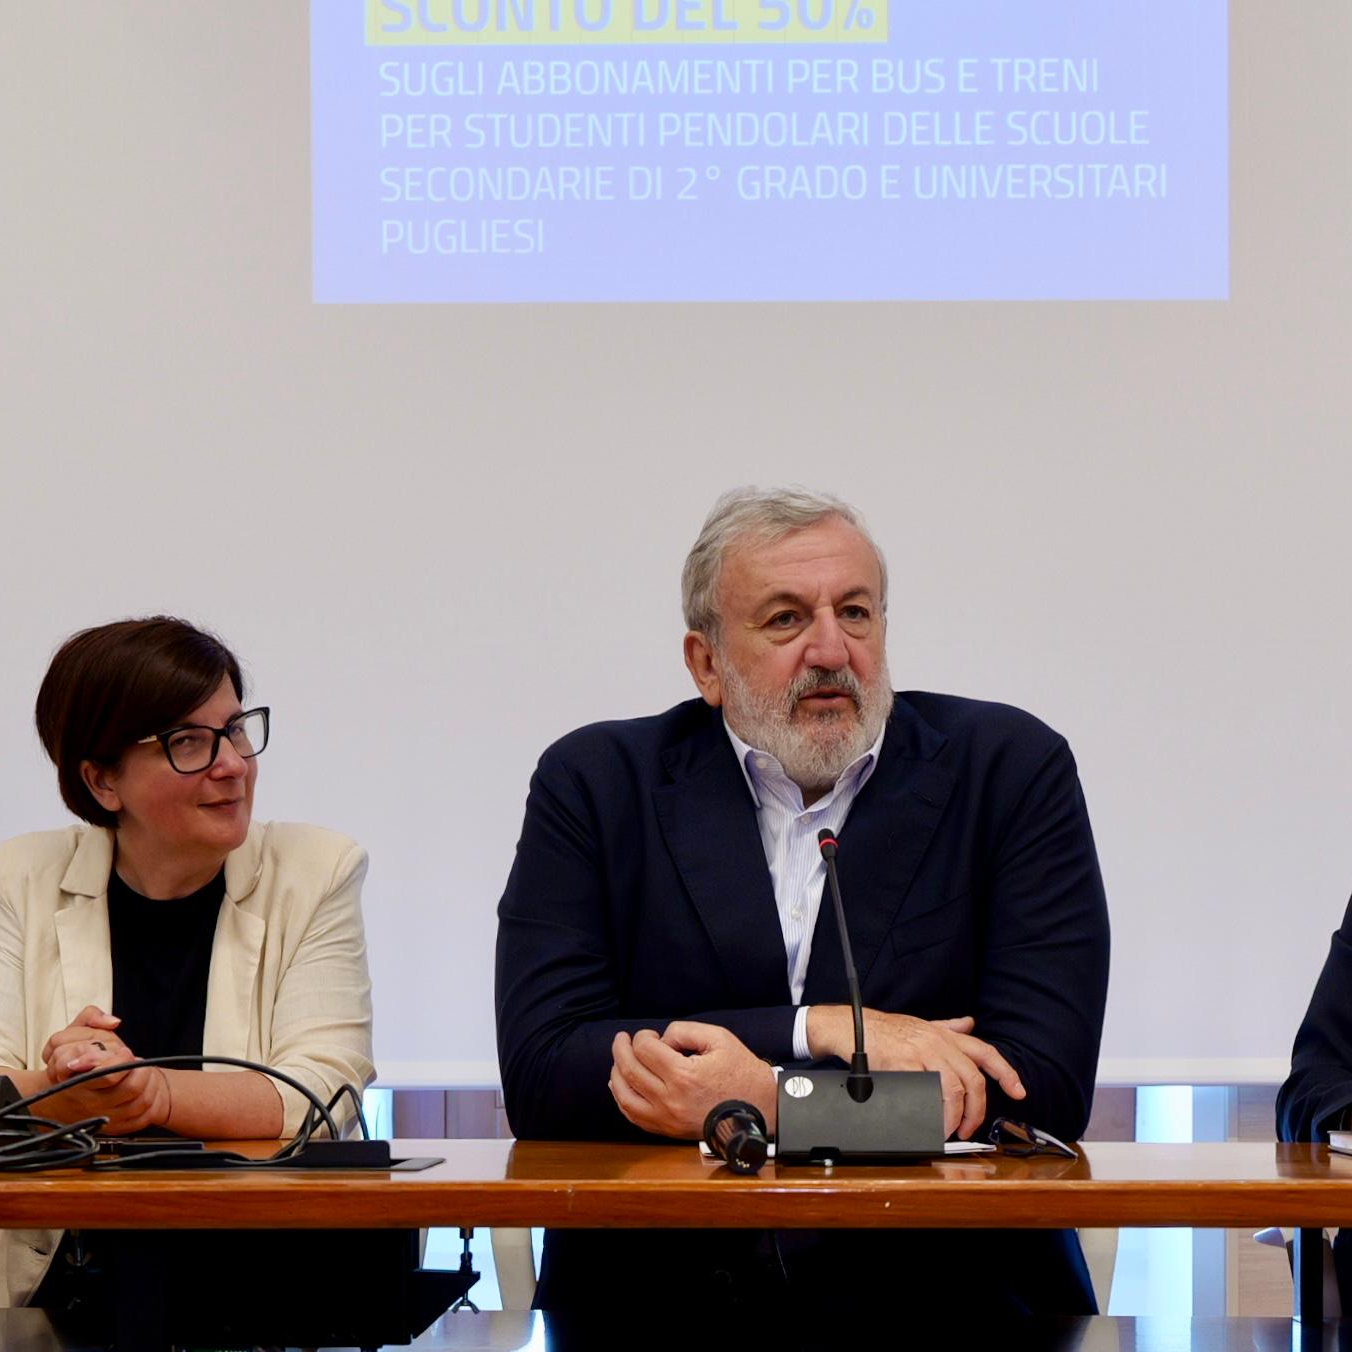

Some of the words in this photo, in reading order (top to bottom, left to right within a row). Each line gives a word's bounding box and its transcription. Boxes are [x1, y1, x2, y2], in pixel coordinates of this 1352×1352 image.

[633, 0, 739, 31] DEL
[379, 61, 485, 97] SUGLI
[496, 59, 774, 96] ABBONAMENTI
[787, 58, 860, 94] PER
[871, 58, 946, 94] BUS
[957, 58, 979, 93] E
[990, 57, 1099, 93] TRENI
[381, 113, 453, 149] PER
[463, 112, 646, 148] STUDENTI
[658, 111, 870, 147] PENDOLARI
[883, 110, 996, 146] DELLE
[1006, 109, 1151, 146] SCUOLE
[380, 166, 615, 203] SECONDARIE
[627, 166, 664, 201] DI
[736, 164, 868, 200] GRADO
[880, 164, 902, 199] E
[913, 163, 1168, 199] UNIVERSITARI
[381, 219, 545, 255] PUGLIESI
